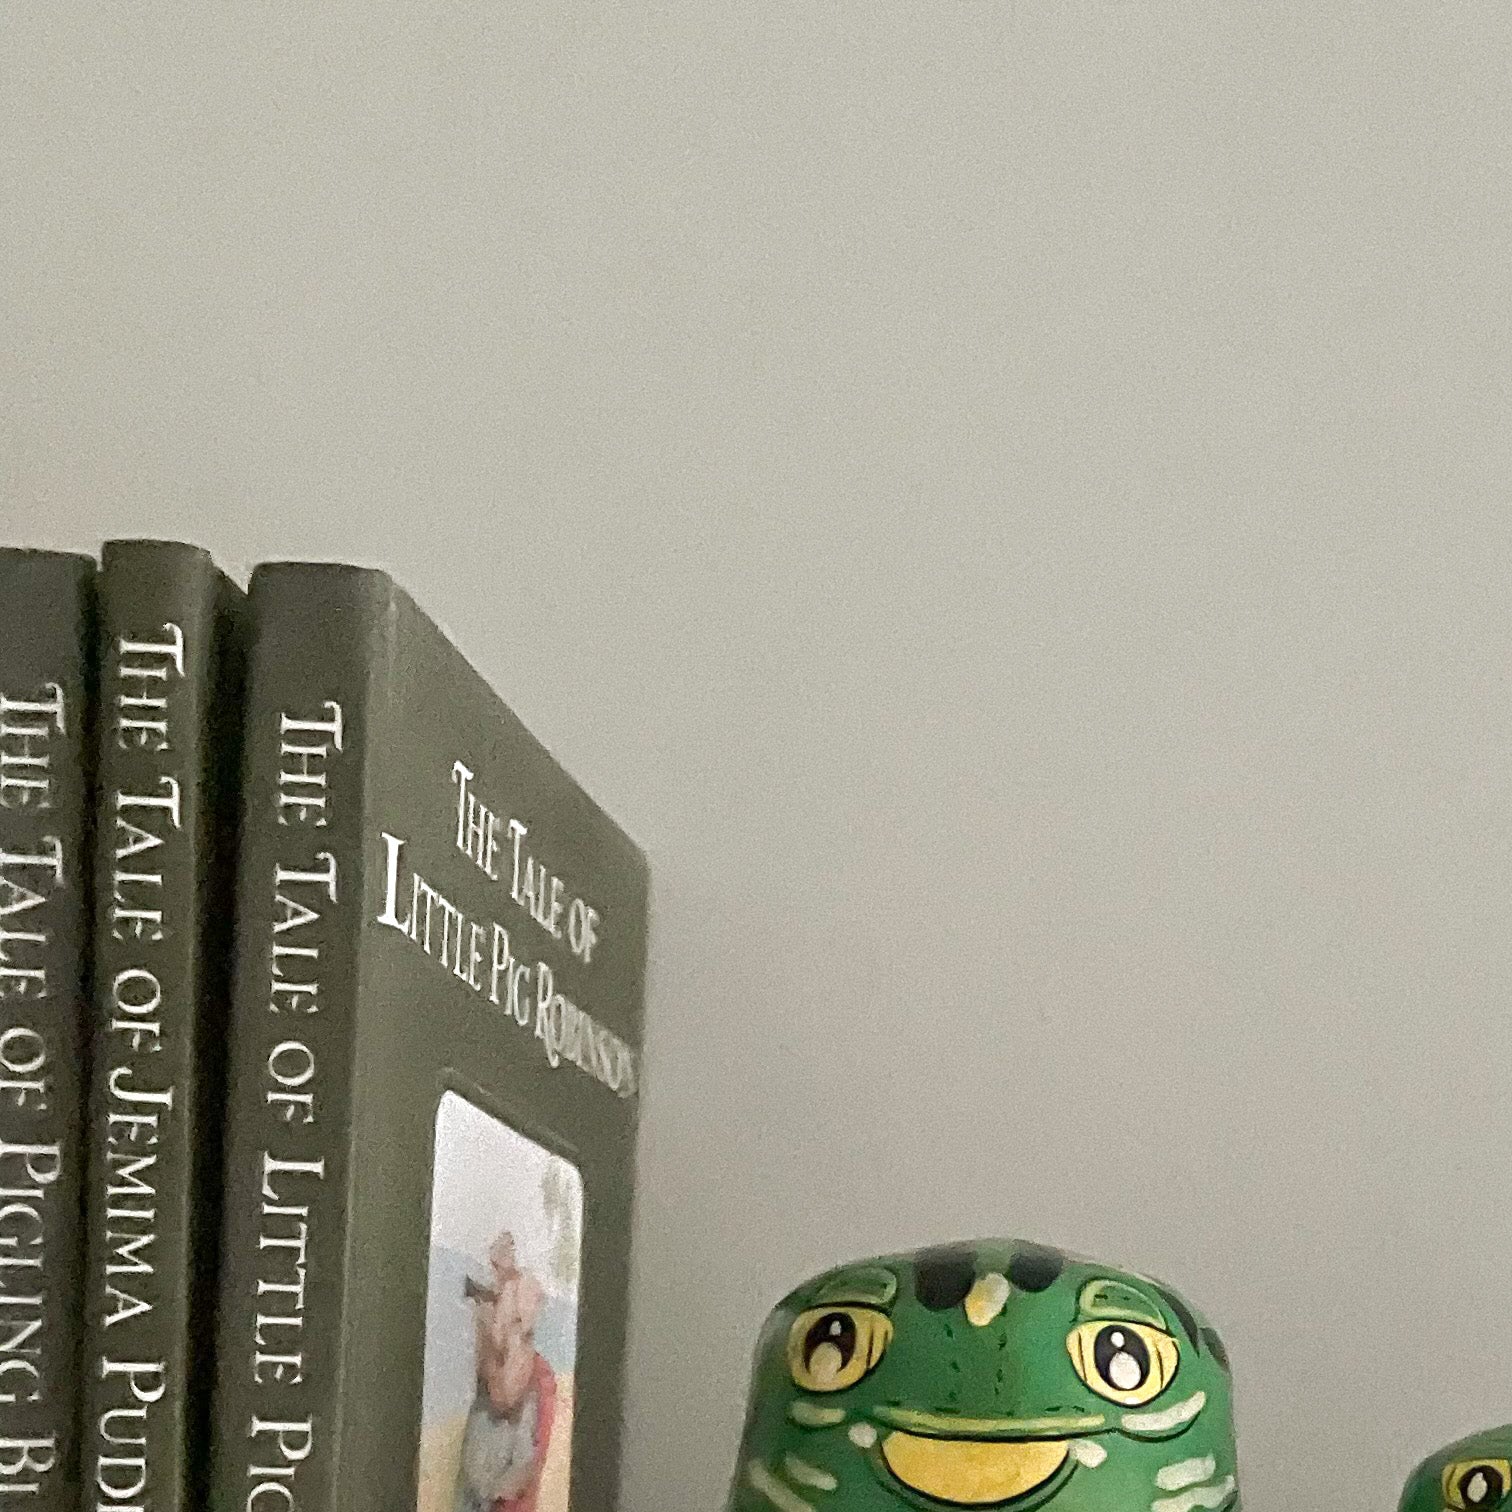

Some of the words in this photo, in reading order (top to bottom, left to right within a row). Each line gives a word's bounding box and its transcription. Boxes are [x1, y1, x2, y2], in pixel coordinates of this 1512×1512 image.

[0, 682, 65, 808] THE
[118, 623, 186, 751] THE
[276, 701, 343, 826] THE
[0, 835, 64, 998] TALE
[113, 776, 181, 940] TALE
[269, 852, 337, 1013] TALE
[377, 831, 485, 992] LITTLE
[489, 921, 531, 1027] PIG
[452, 760, 500, 881] THE
[508, 818, 565, 940] TALE
[567, 898, 599, 963] OF
[0, 1028, 47, 1110] OF
[110, 969, 161, 1052] OF
[267, 1041, 314, 1123] OF
[103, 1066, 174, 1327] JEMIMA
[253, 1151, 324, 1384] LITTLE
